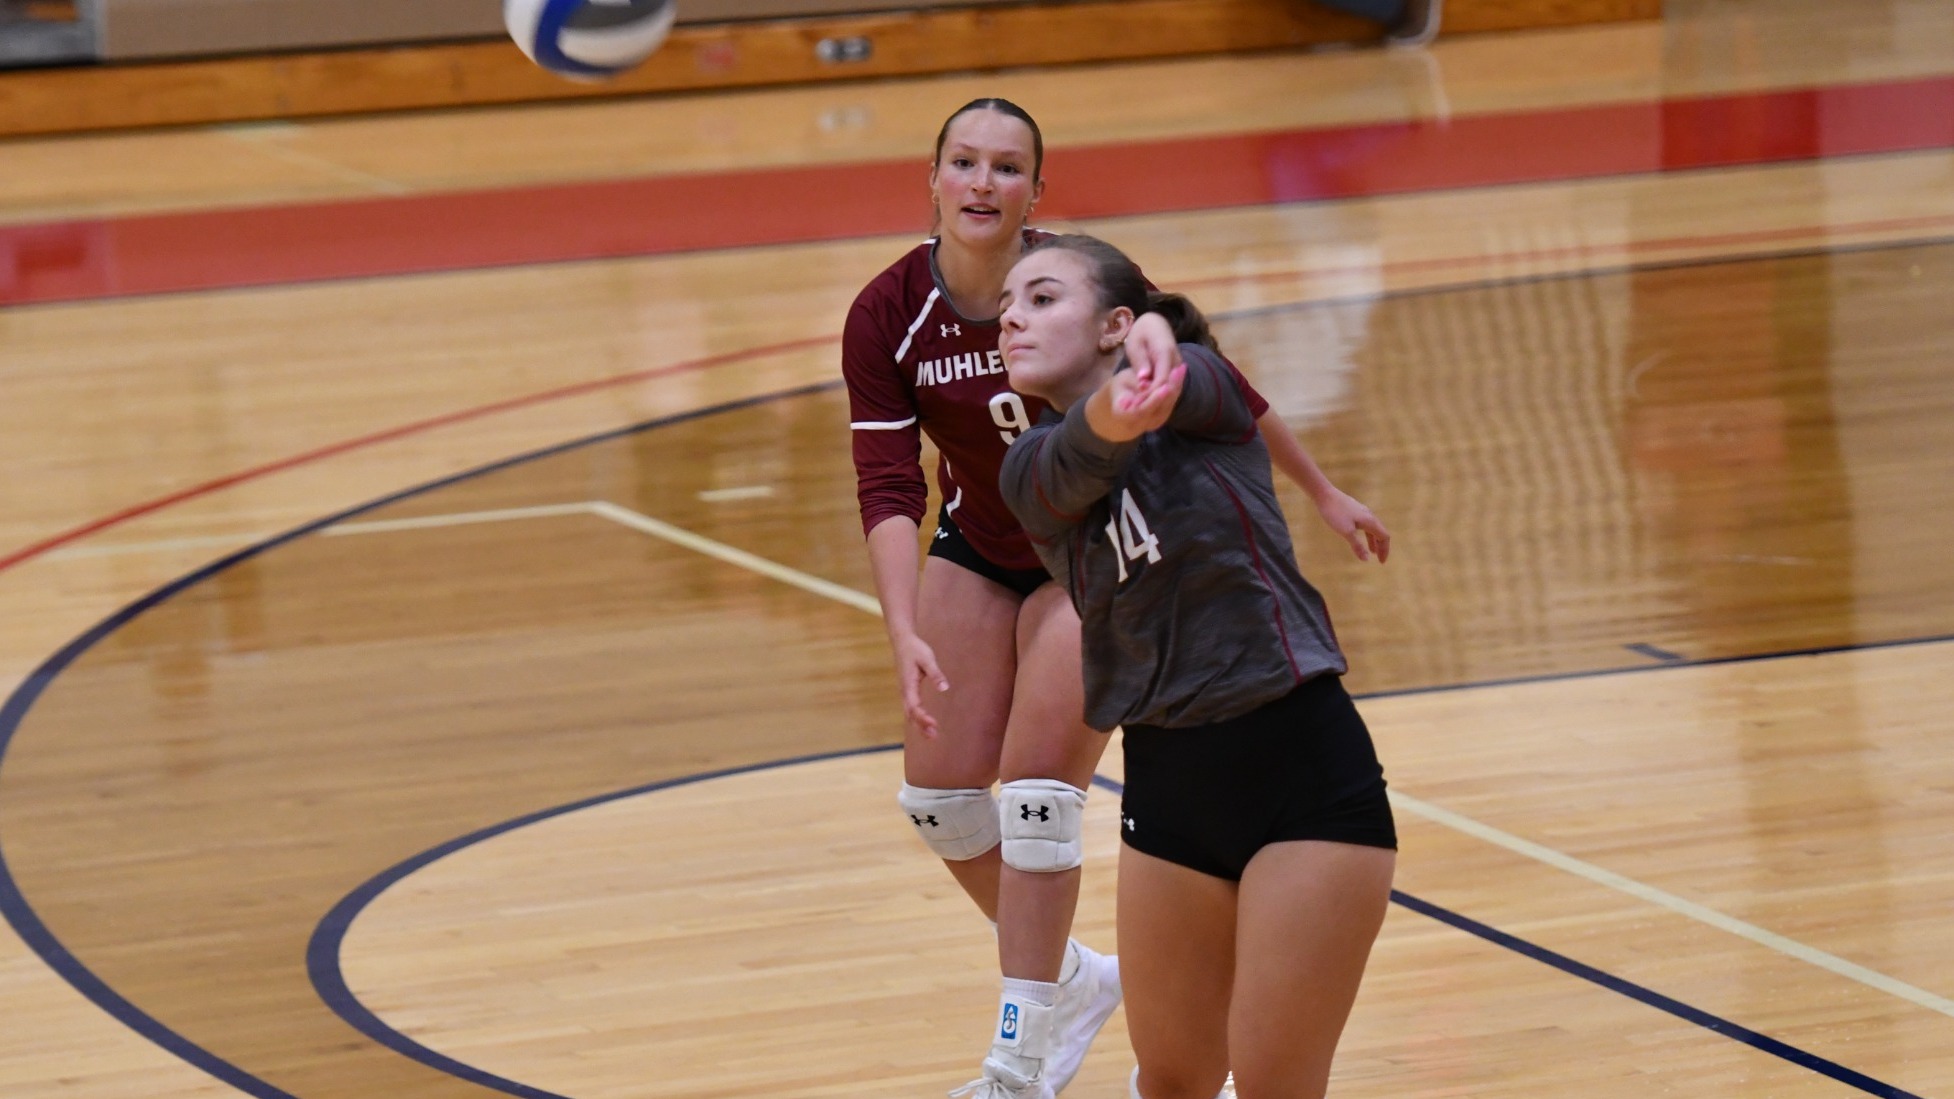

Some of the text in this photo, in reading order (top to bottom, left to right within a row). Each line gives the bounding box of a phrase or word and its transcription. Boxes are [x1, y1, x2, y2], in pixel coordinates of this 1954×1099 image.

[915, 349, 1008, 387] MUHLE
[988, 392, 1031, 446] 9
[1104, 487, 1162, 583] 14
